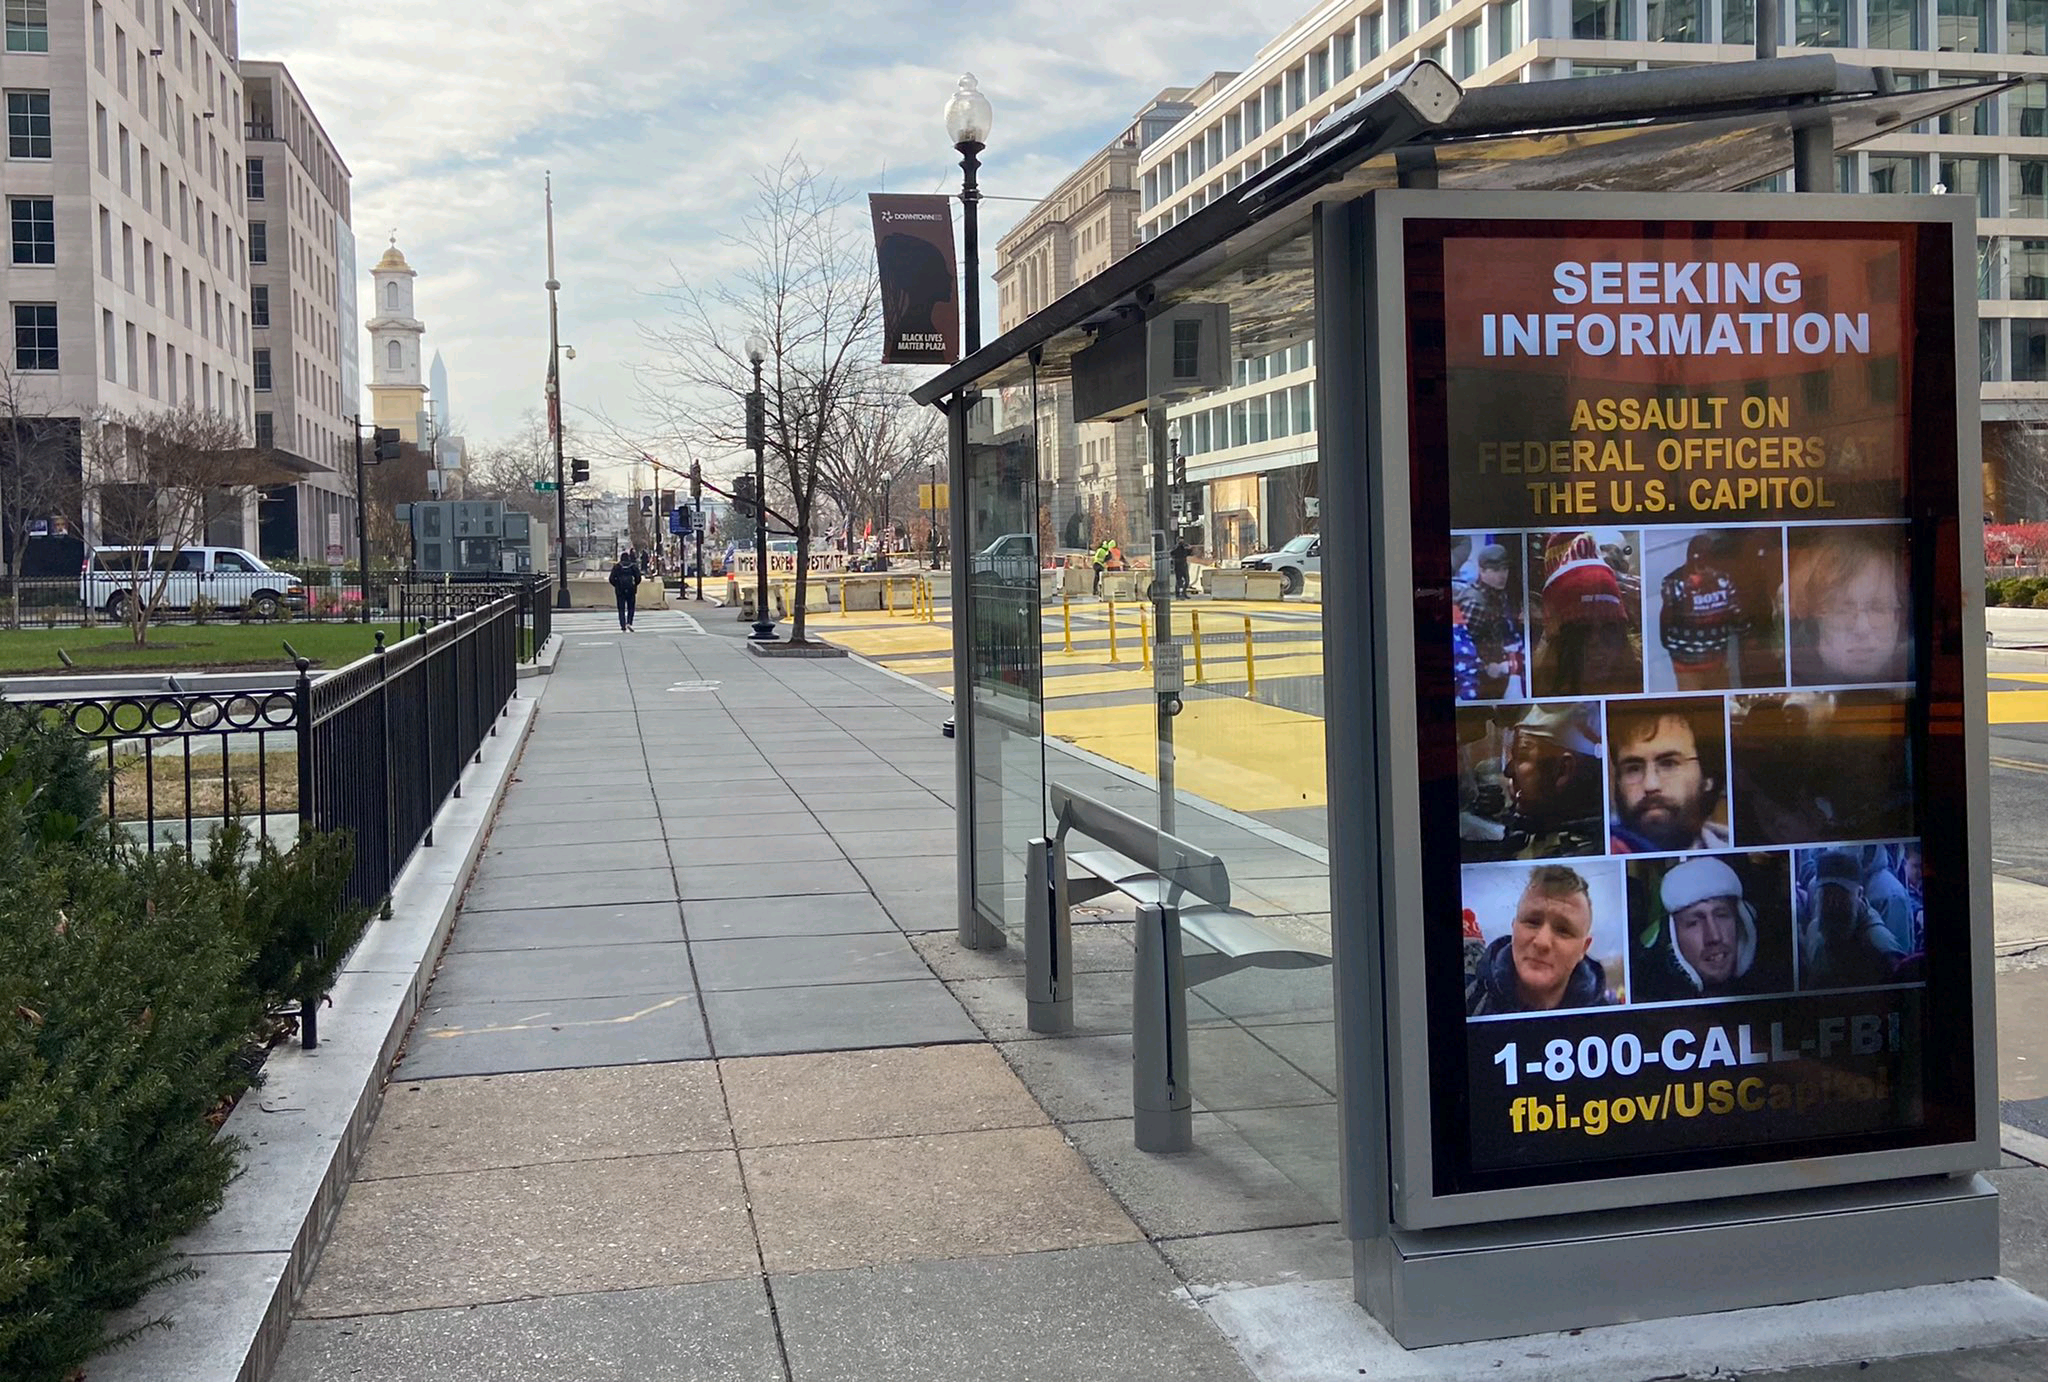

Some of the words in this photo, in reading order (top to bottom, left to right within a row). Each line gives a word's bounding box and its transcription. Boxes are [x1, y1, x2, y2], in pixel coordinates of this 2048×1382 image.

[1552, 261, 1801, 304] SEEKING
[897, 342, 924, 350] MATTER
[925, 342, 946, 351] PLAZA
[901, 333, 923, 342] BLACK
[924, 333, 943, 342] LIVES
[1482, 313, 1870, 356] INFORMATION
[1570, 397, 1728, 431] ASSAULT
[1740, 396, 1789, 429] ON
[1479, 439, 1644, 474] FEDERAL
[1656, 436, 1826, 471] OFFICERS
[1527, 481, 1597, 515] THE
[1610, 479, 1675, 512] U.S.
[1689, 477, 1835, 511] CAPITOL
[807, 554, 843, 571] ESTIGATE
[1493, 1011, 1899, 1085] 1-800-CALL-FBI
